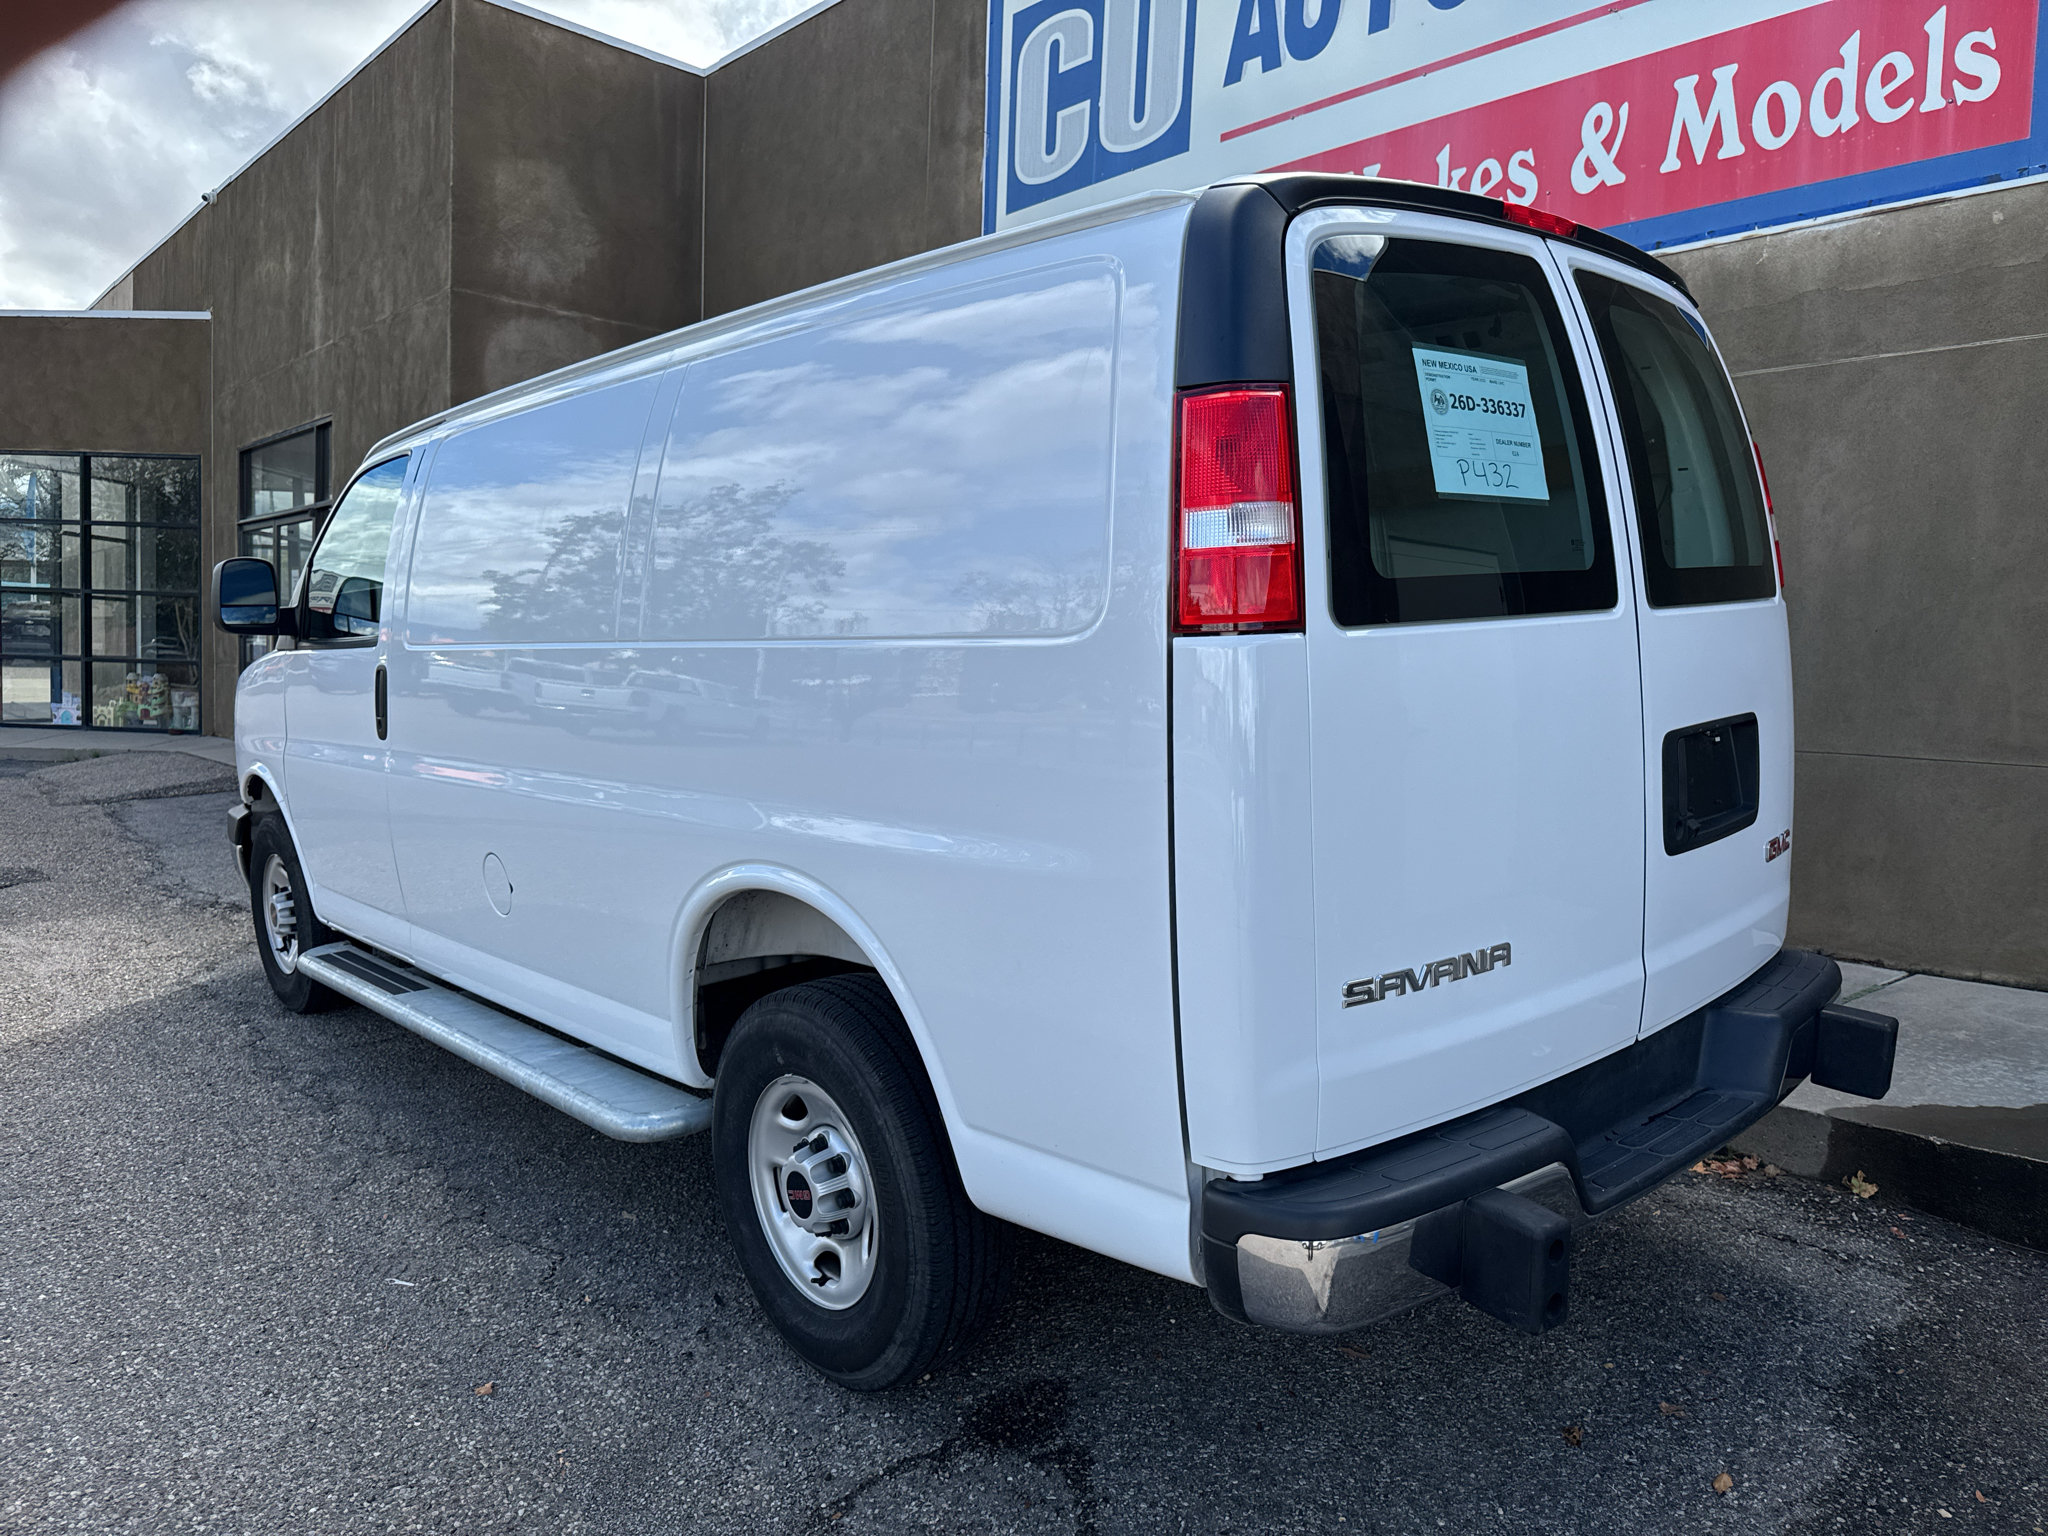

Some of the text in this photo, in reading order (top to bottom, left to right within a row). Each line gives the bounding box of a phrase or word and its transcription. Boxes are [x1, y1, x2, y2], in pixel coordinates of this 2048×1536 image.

[1014, 0, 1188, 185] CU
[1570, 101, 1629, 194] &
[1659, 5, 2002, 174] Models
[1421, 358, 1437, 368] NEW
[1438, 360, 1463, 372] MEXICO
[1464, 364, 1478, 374] USA
[1448, 393, 1526, 418] 26D-336337
[1495, 438, 1513, 446] DEALER
[1456, 458, 1519, 489] P432
[1763, 828, 1791, 863] GMC
[1341, 941, 1512, 1010] SAVANA
